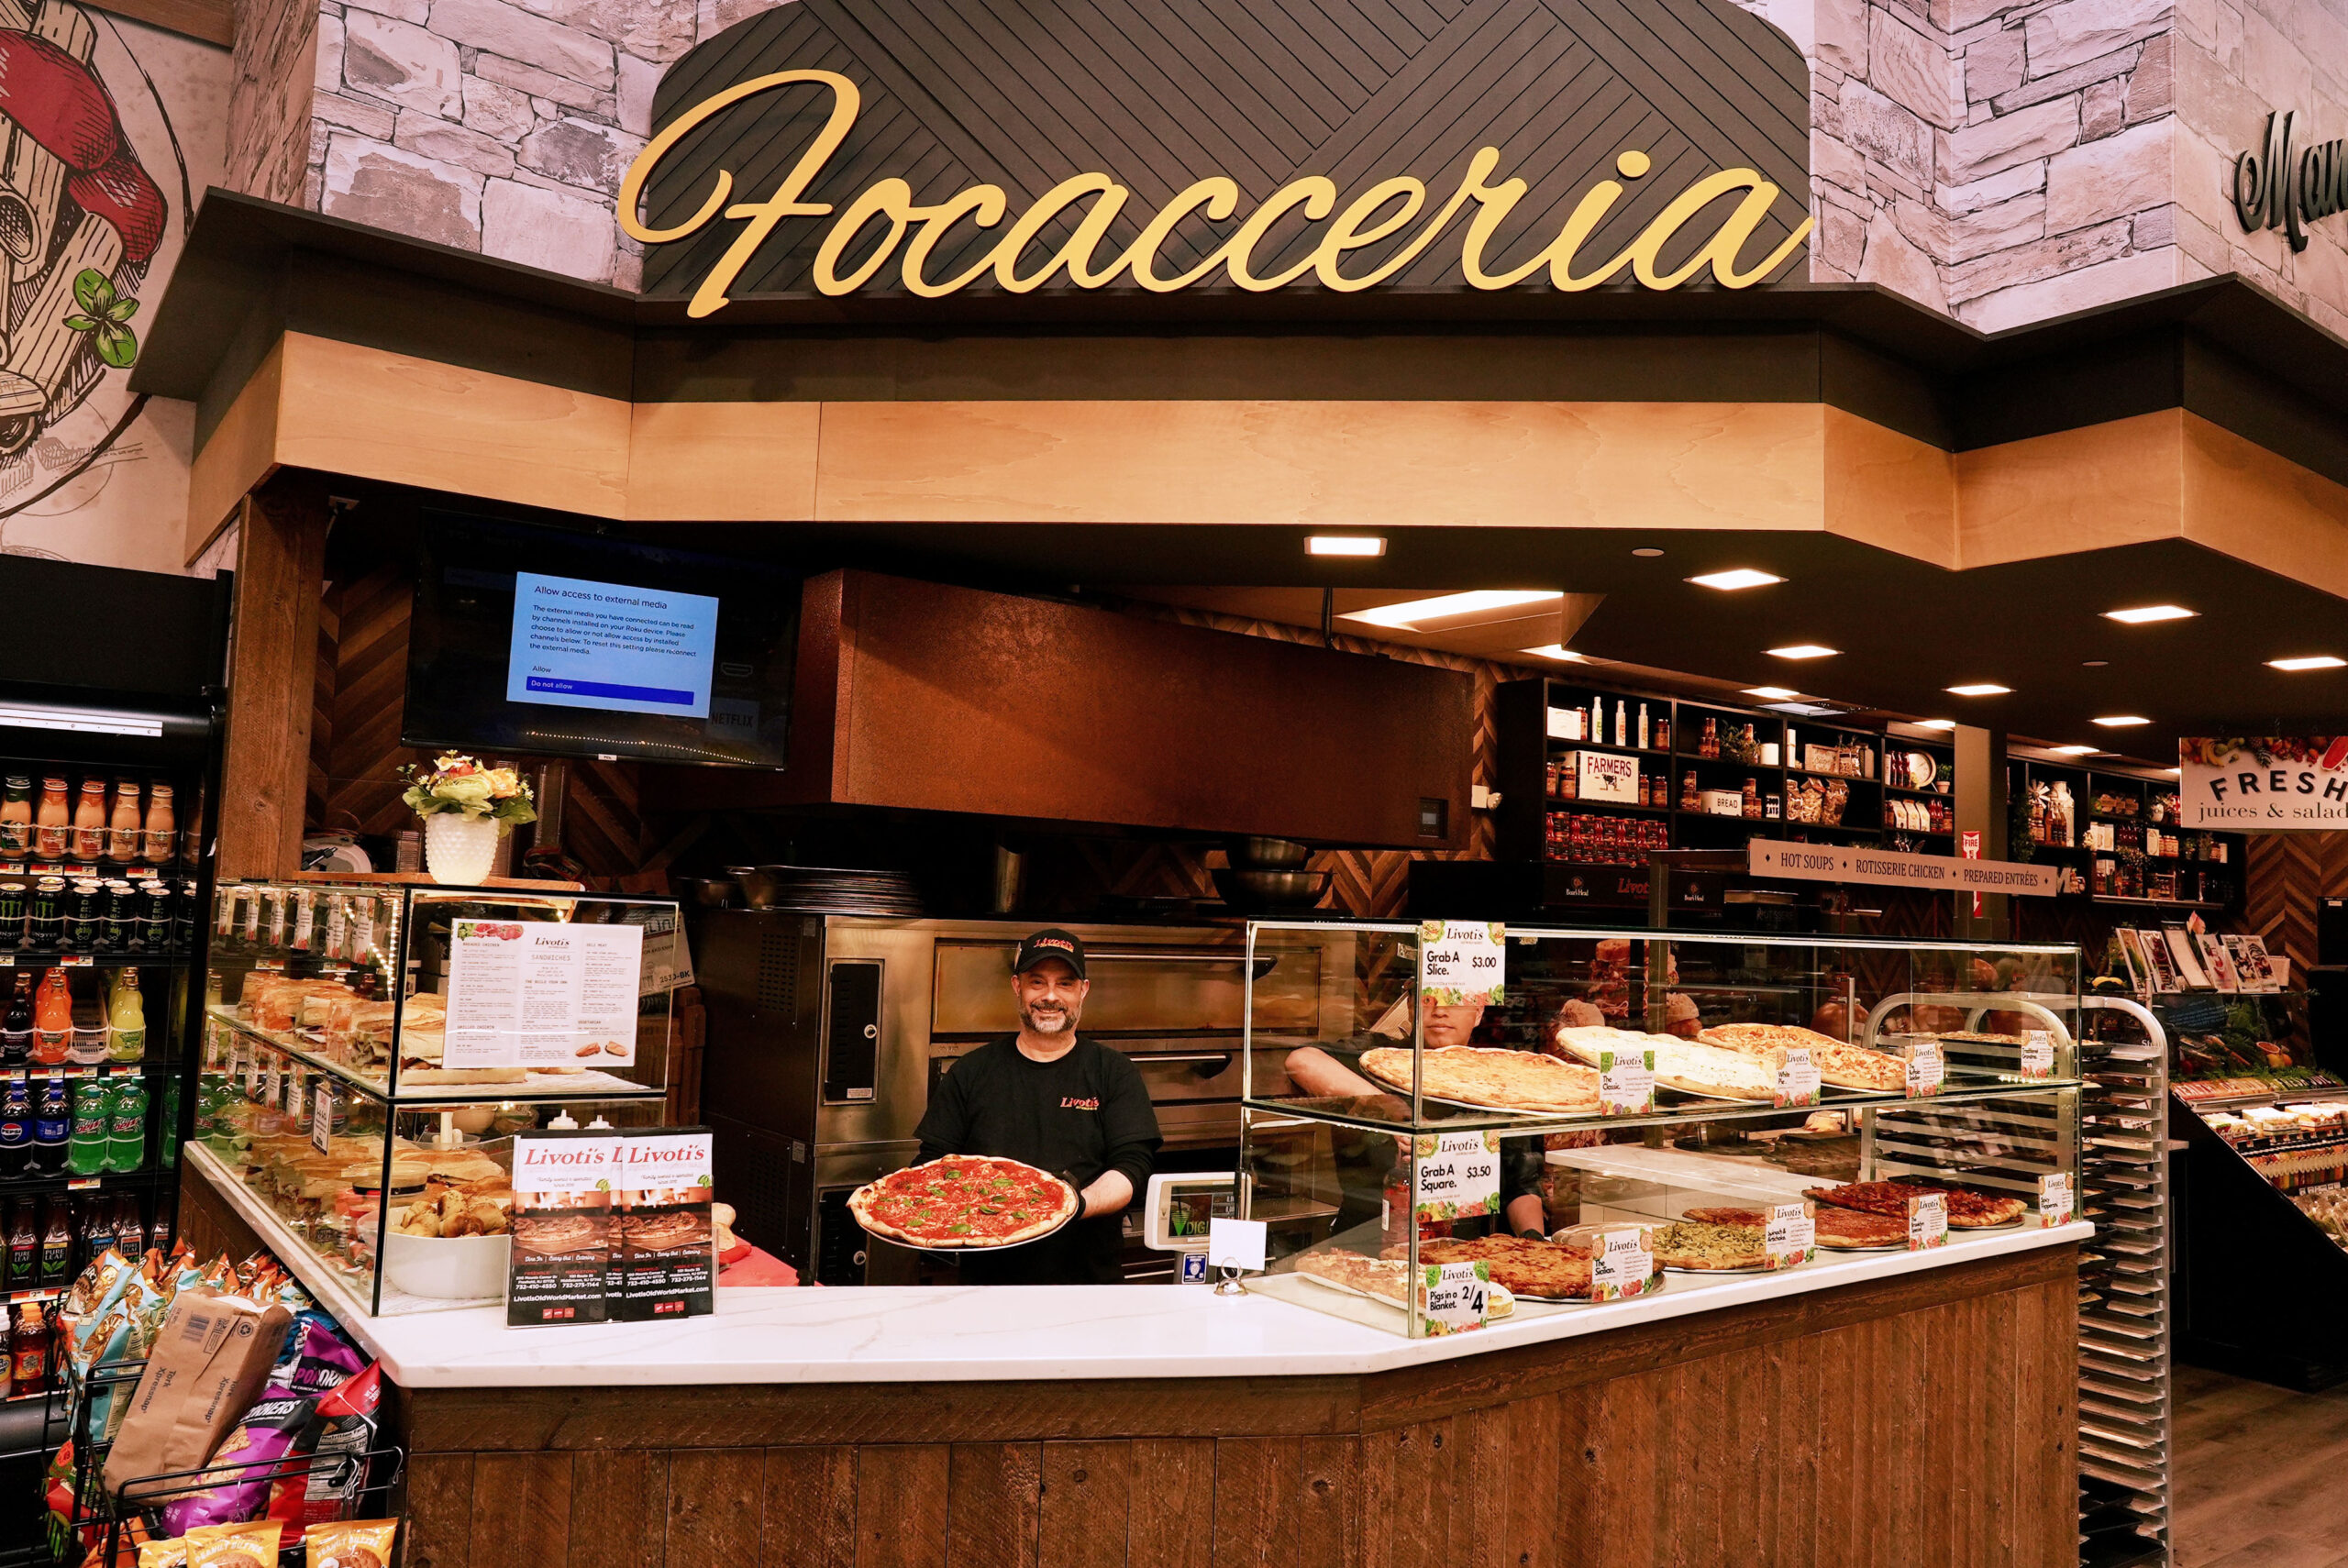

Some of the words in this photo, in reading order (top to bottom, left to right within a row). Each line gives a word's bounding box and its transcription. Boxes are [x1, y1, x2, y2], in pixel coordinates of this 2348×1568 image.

[617, 69, 1813, 317] Focacceria
[535, 586, 559, 596] Allow
[562, 590, 591, 601] access
[594, 591, 603, 602] to
[605, 596, 639, 606] external
[642, 600, 667, 610] media
[547, 606, 573, 615] external
[574, 609, 594, 618] media
[596, 613, 608, 622] you
[609, 613, 624, 622] have
[626, 616, 658, 625] connected
[532, 614, 540, 623] by
[542, 616, 570, 624] channels
[572, 619, 599, 628] installed
[611, 624, 625, 632] your
[666, 629, 686, 637] Please
[530, 633, 559, 642] channels
[623, 644, 643, 652] setting
[646, 646, 665, 654] please
[666, 647, 696, 657] reconnect
[565, 627, 581, 635] allow
[653, 637, 679, 646] installed
[542, 644, 569, 653] external
[711, 712, 754, 726] NETFLIX
[1588, 756, 1632, 778] FARMERS
[2209, 770, 2348, 802] FRESH
[1717, 798, 1738, 809] BREAD
[2198, 801, 2257, 823] juices
[2267, 803, 2284, 819] &
[1965, 839, 1978, 847] FIRE
[1781, 853, 1802, 868] HOT
[1803, 855, 1834, 871] SOUPS
[1855, 859, 1907, 877] ROTISSERIE
[1908, 864, 1945, 879] CHICKEN
[1617, 878, 1650, 894] Livot
[1964, 869, 2003, 885] PREPARED
[2005, 870, 2039, 887] ENTRÉES
[1447, 928, 1484, 941] Livoti's
[1427, 951, 1451, 963] Grab
[1453, 952, 1460, 963] A
[1472, 956, 1497, 969] $3.00
[1427, 964, 1450, 976] Slice.
[627, 1144, 704, 1164] Livoti's
[1442, 1139, 1479, 1153] Livoti's
[525, 1148, 604, 1165] Livoti's
[1422, 1165, 1445, 1178] Grab
[1447, 1164, 1455, 1176] A
[1468, 1165, 1491, 1179] $3.50
[1421, 1179, 1457, 1194] Square.
[1187, 1221, 1209, 1234] DIGI
[514, 1294, 601, 1302] LivotisOldWorldMarket.com
[626, 1287, 709, 1298] LivotisOldWorldMarket.com
[1431, 1291, 1444, 1303] Pigs
[1445, 1290, 1452, 1299] in
[163, 1370, 176, 1388] Tork
[226, 1379, 239, 1397] Tork
[195, 1540, 230, 1562] PEANUT
[231, 1540, 263, 1554] BUTTER
